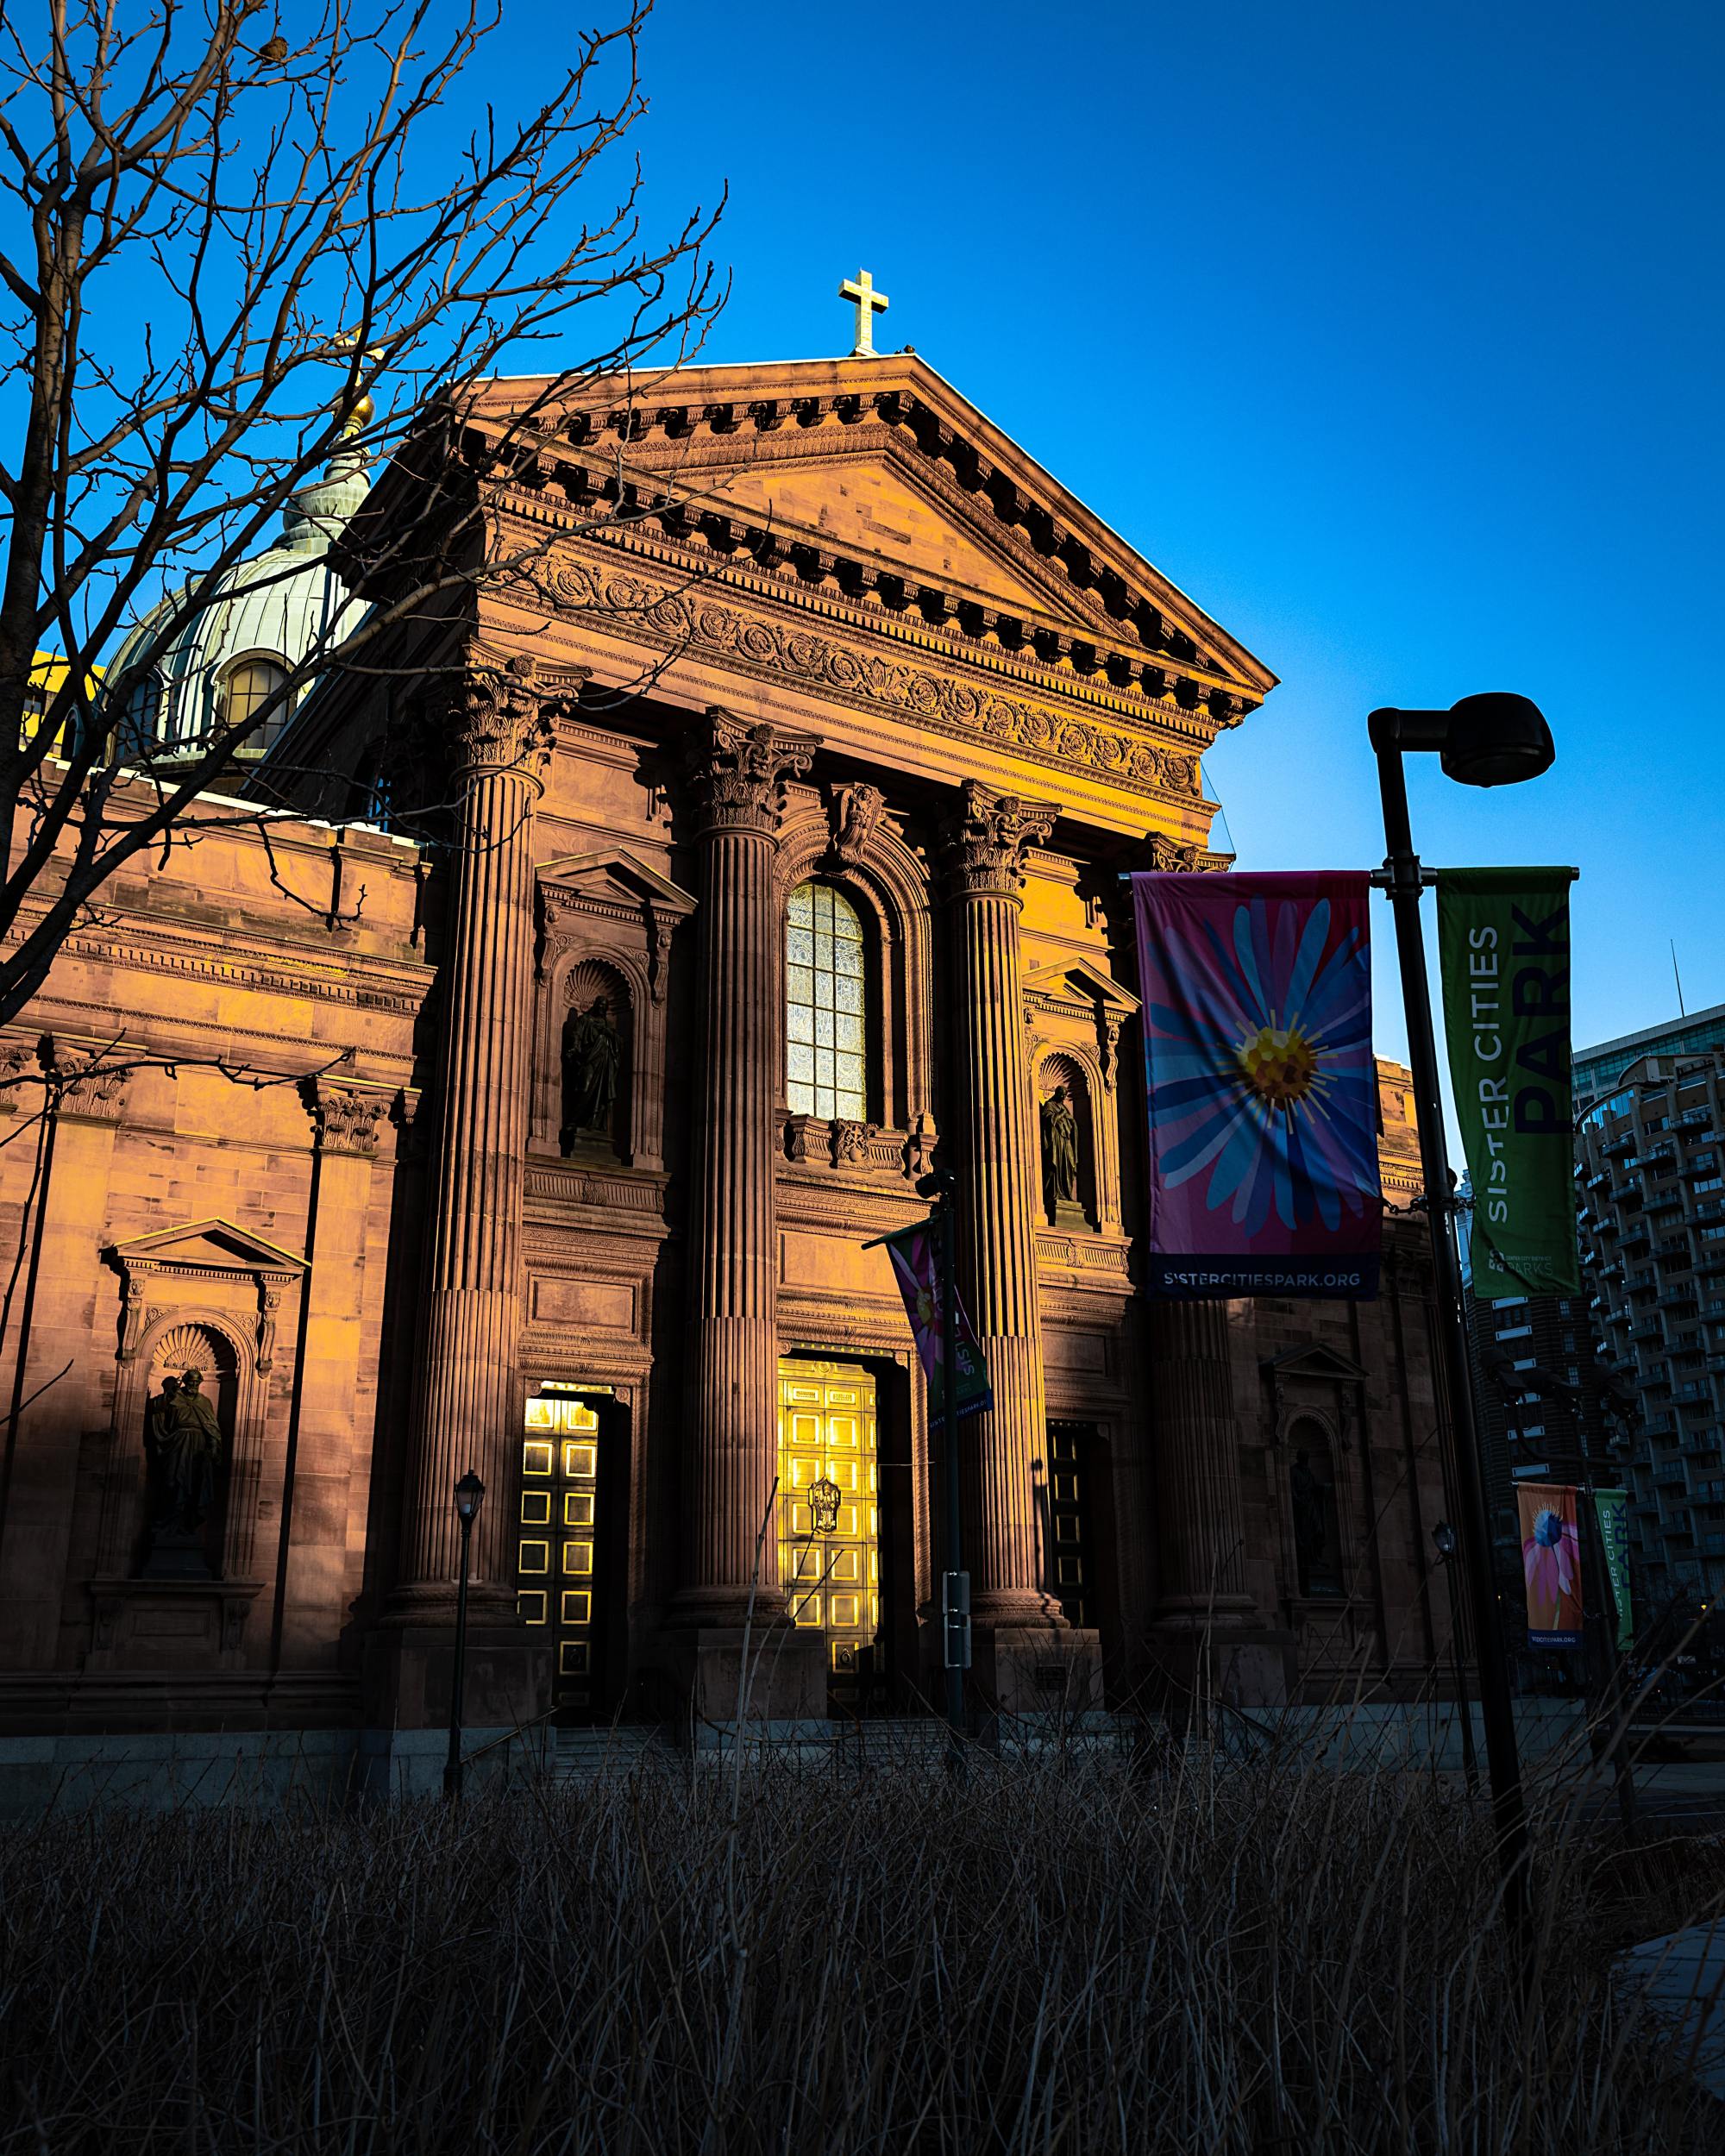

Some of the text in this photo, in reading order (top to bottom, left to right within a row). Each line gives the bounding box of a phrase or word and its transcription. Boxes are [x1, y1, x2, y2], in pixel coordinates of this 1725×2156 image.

[1468, 925, 1502, 1062] CITIES
[1511, 903, 1572, 1134] PARK
[1478, 1076, 1509, 1224] SISTER
[1163, 1272, 1360, 1288] SISTERCITIESPARK.ORG
[1603, 1509, 1615, 1561] CITIES
